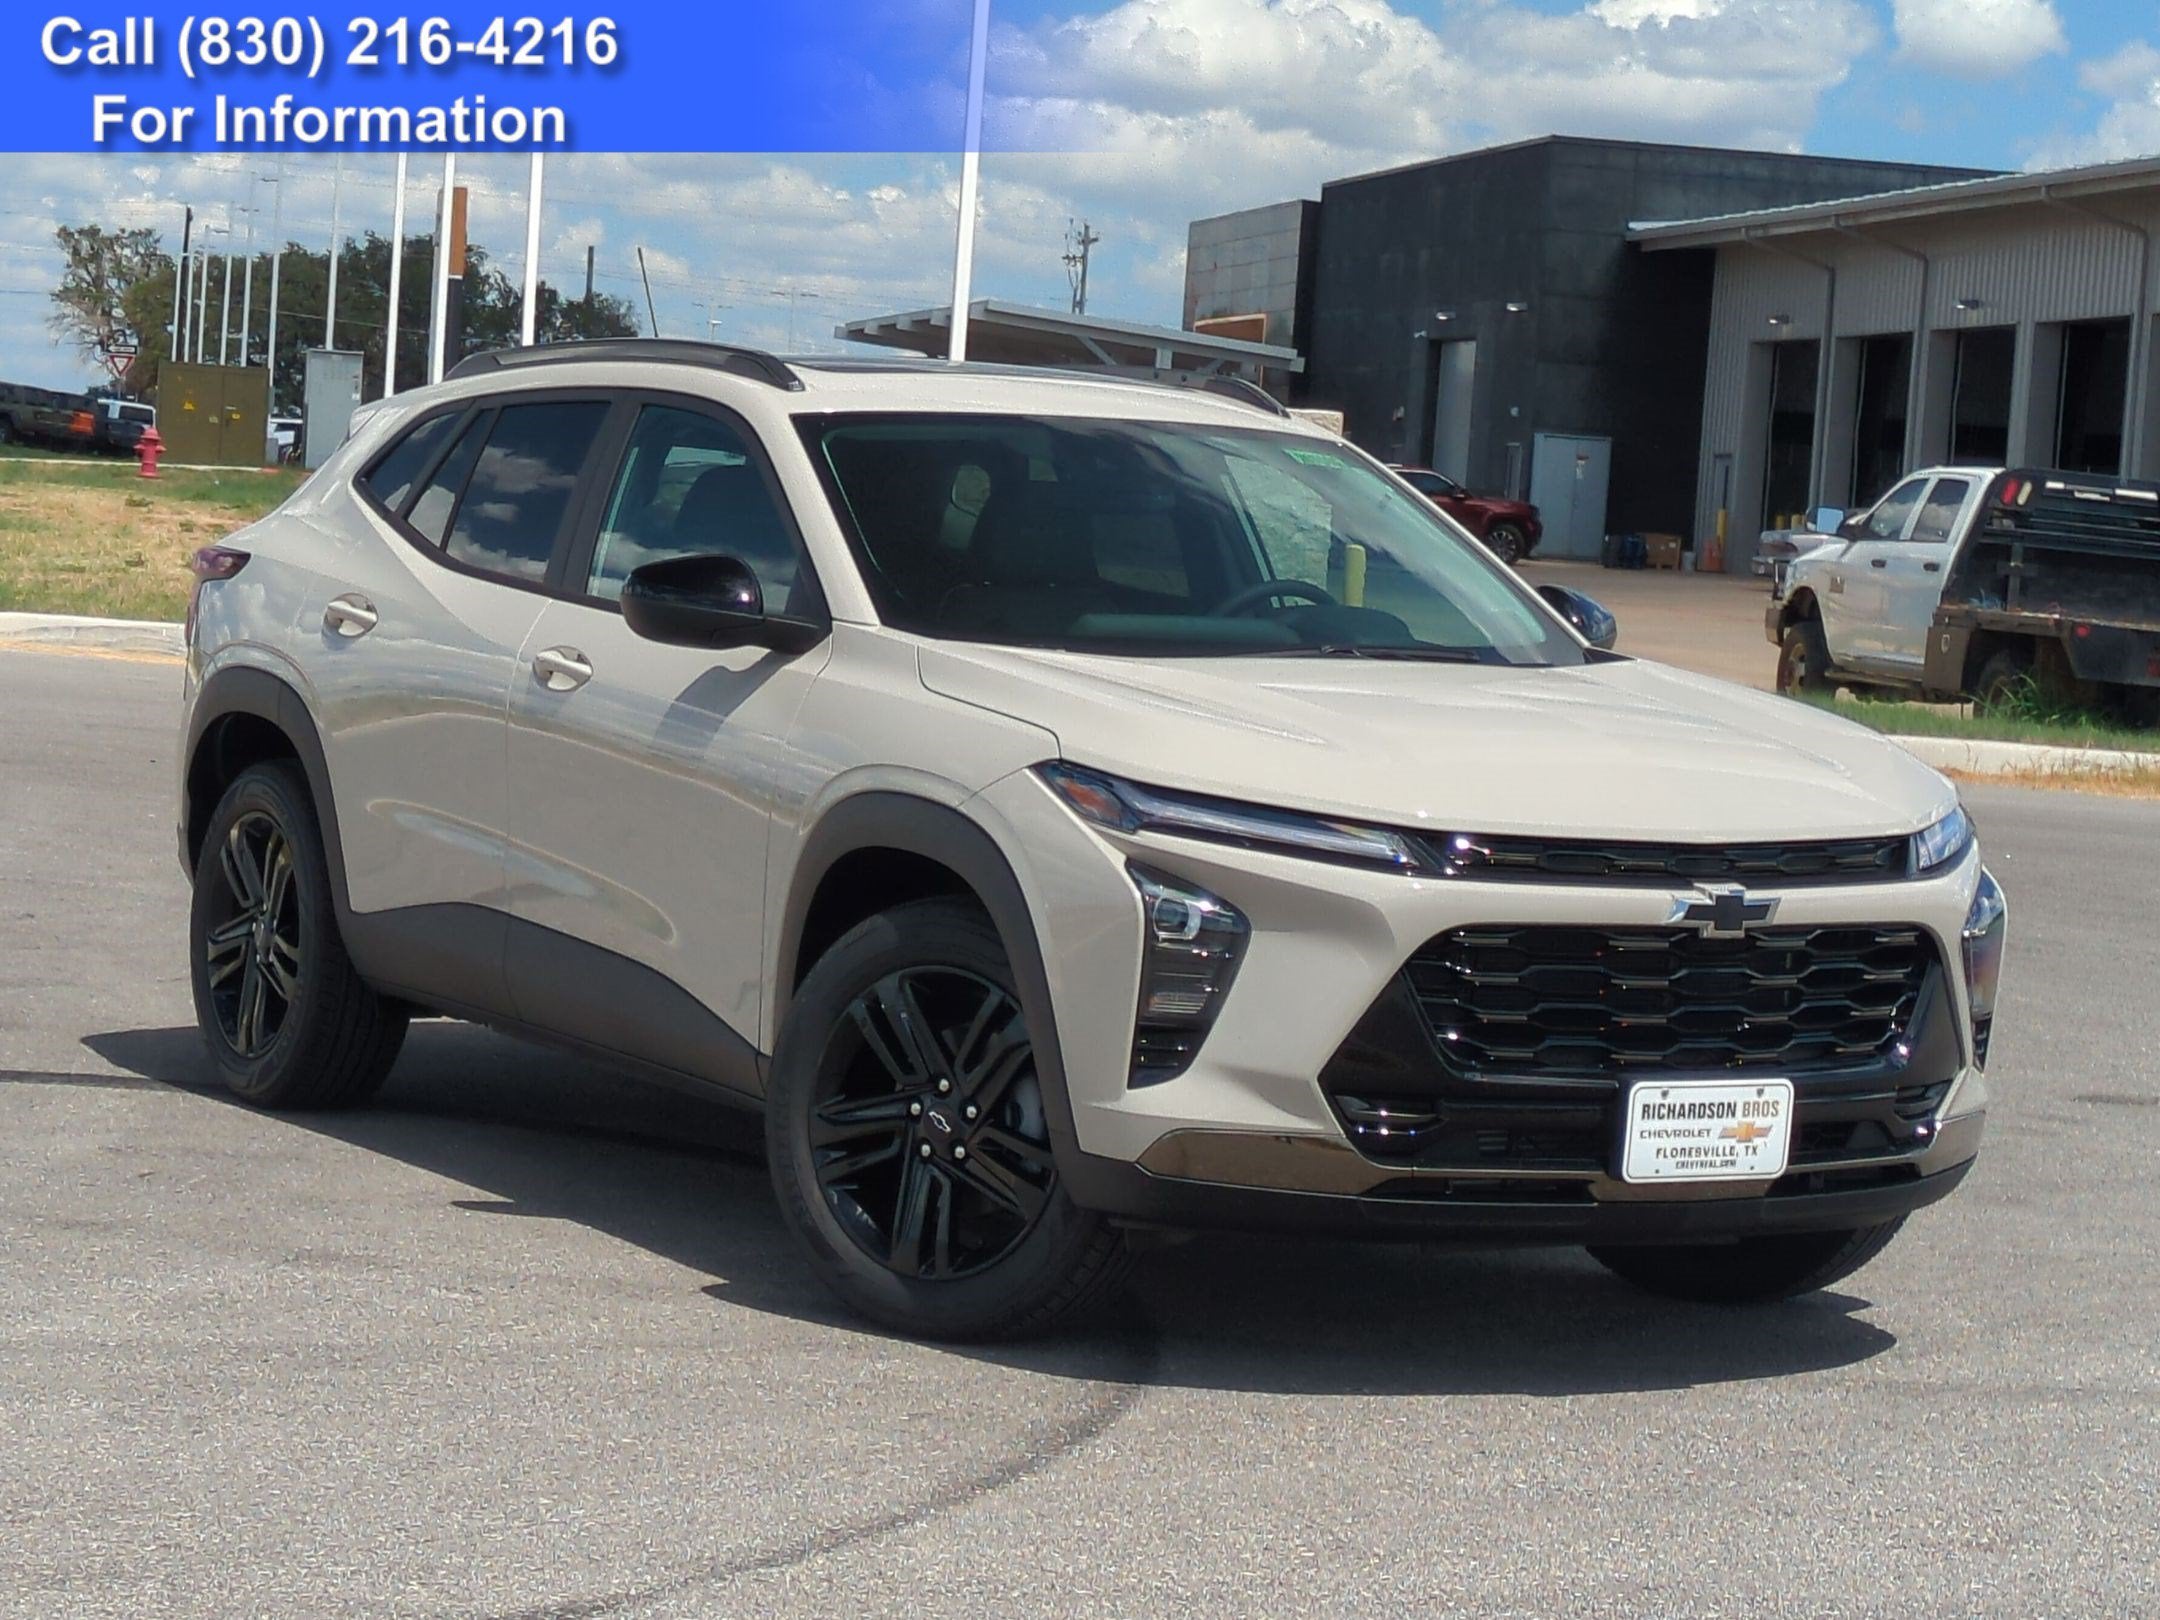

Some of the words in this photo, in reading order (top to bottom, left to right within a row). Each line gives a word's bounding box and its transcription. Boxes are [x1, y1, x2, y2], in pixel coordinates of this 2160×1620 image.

[1641, 1102, 1737, 1121] RICHARDSON
[1742, 1100, 1780, 1118] BROS
[1640, 1128, 1712, 1140] CHEVROLET
[1656, 1145, 1739, 1160] FLORESVILLE,
[1744, 1145, 1759, 1157] TX
